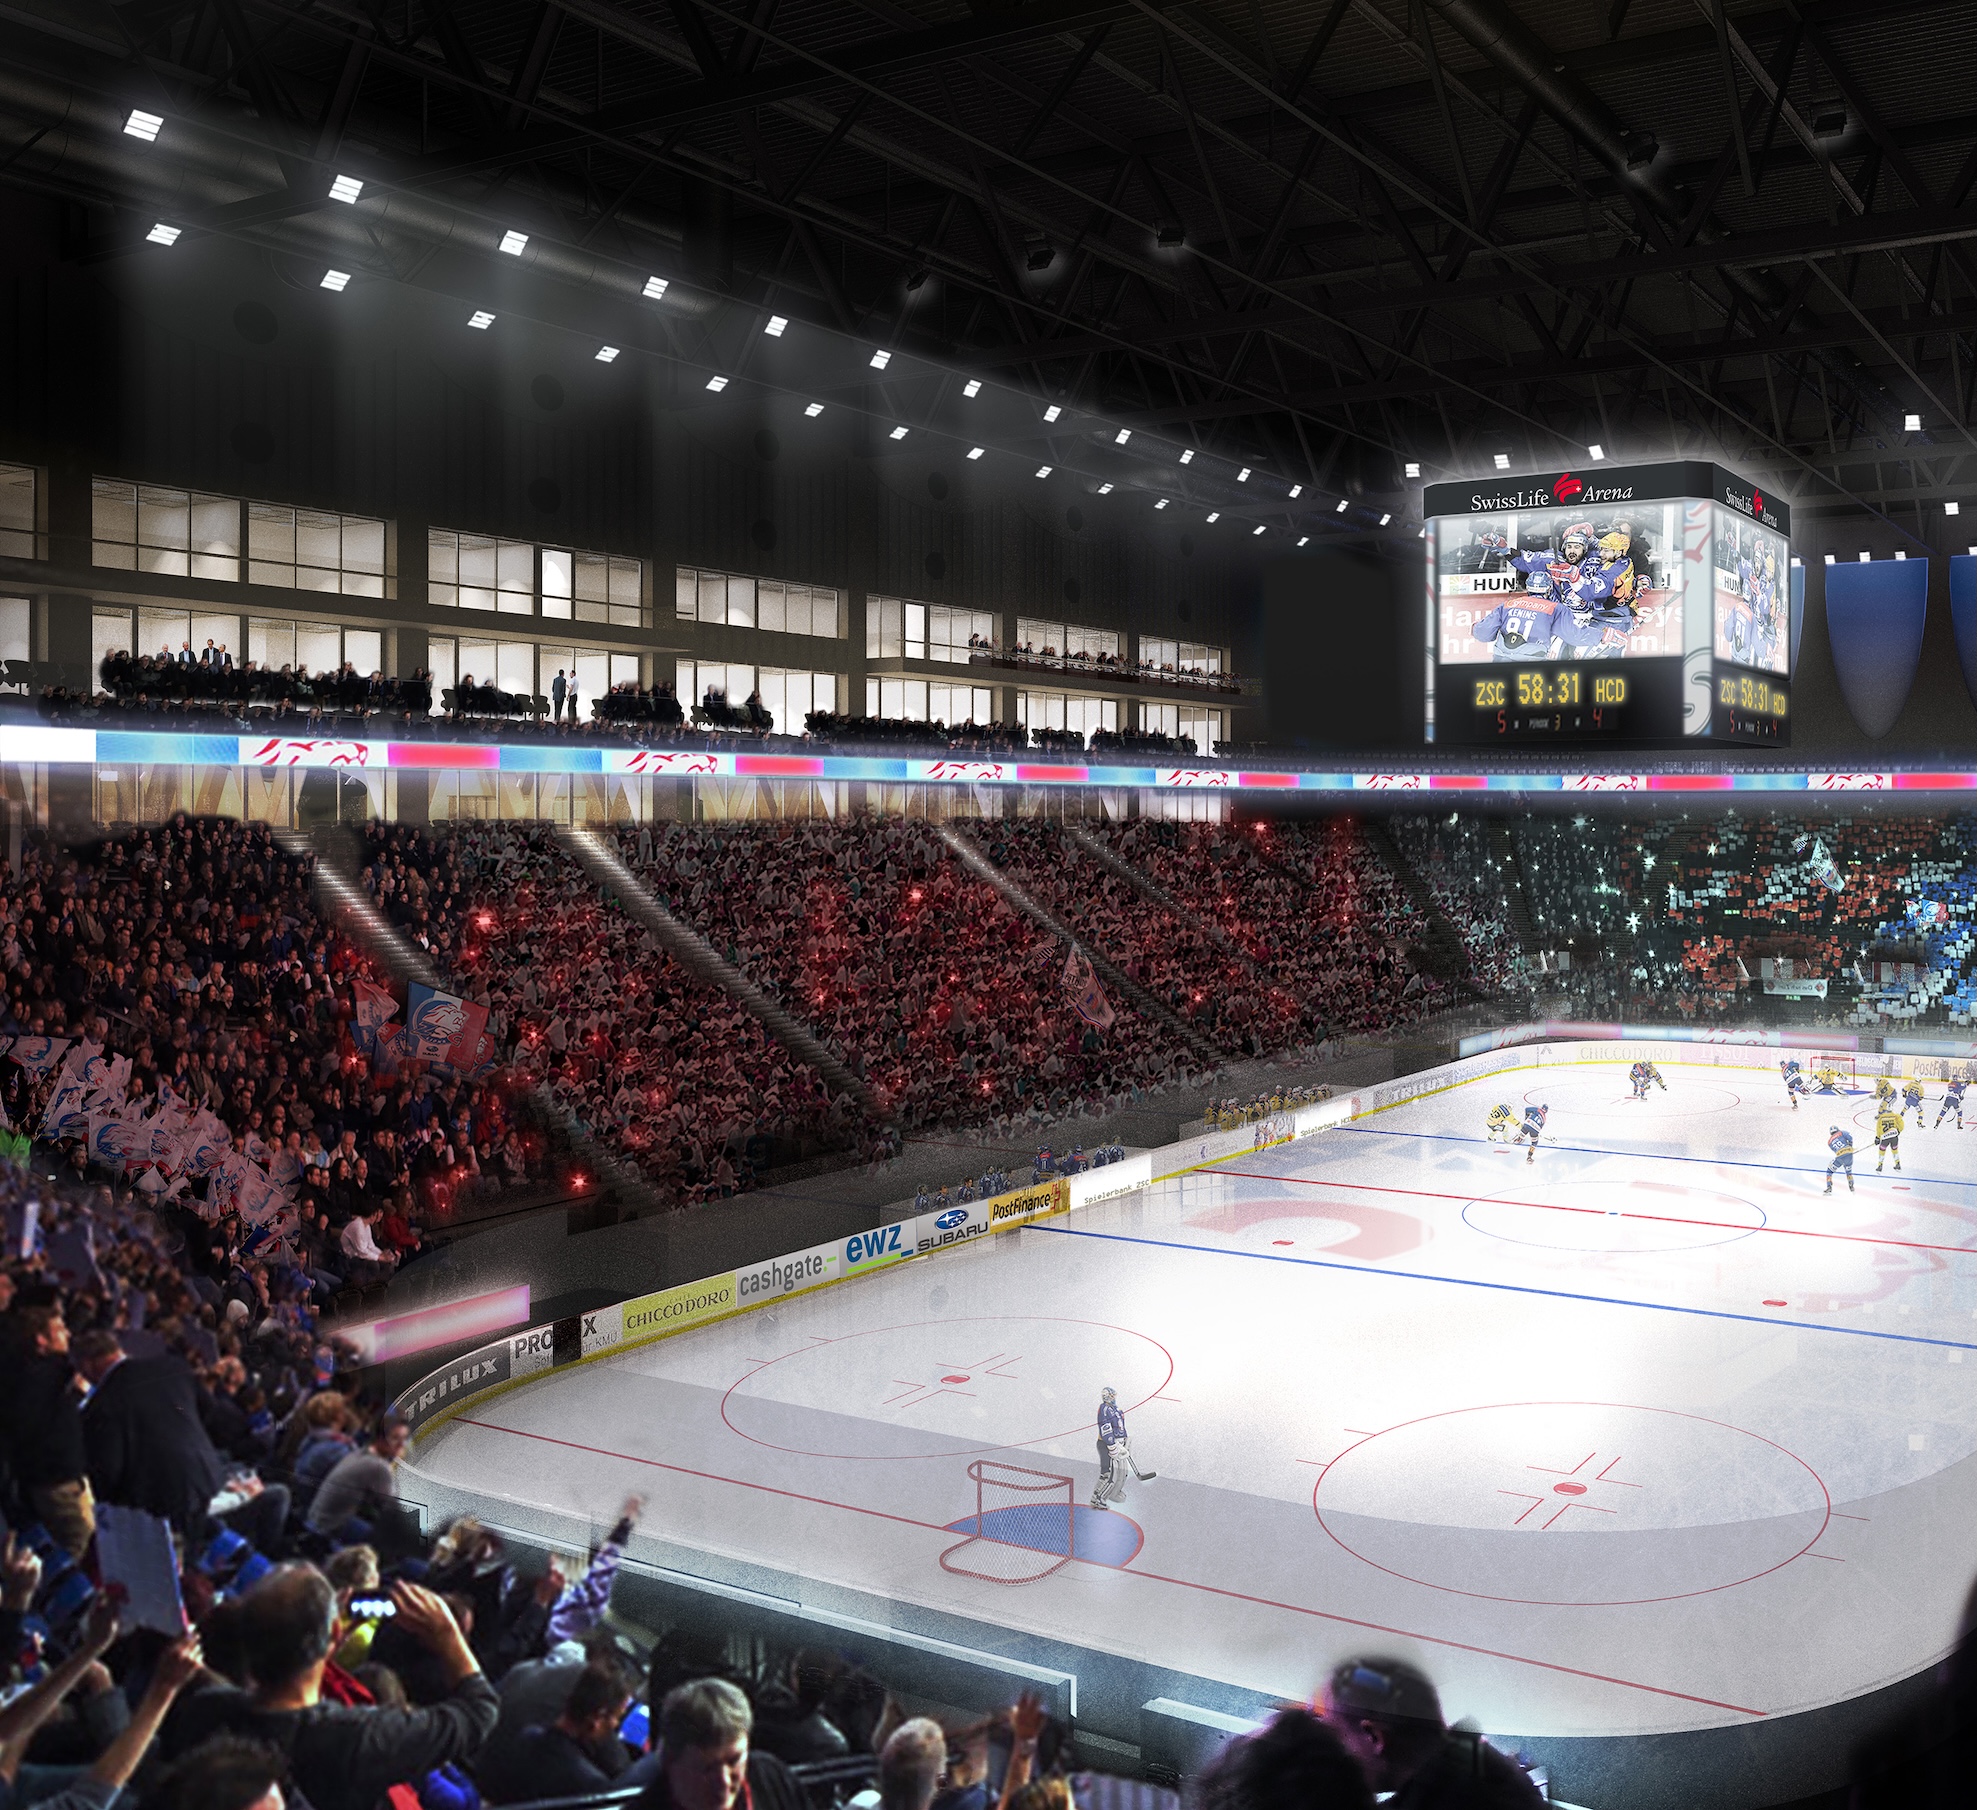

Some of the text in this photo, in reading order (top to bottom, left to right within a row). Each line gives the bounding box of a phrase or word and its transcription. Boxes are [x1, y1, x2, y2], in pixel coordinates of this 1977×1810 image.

[1471, 485, 1634, 511] SwissLife Arena
[1726, 487, 1777, 528] SwissLife Arena
[1476, 673, 1625, 705] ZSC 58:31 HCD
[1721, 679, 1735, 704] ZSC
[1741, 678, 1767, 711] 58:31
[1497, 709, 1506, 733] 5
[992, 1192, 1051, 1221] PostFinance
[1084, 1179, 1150, 1205] Spielerbank ZSC
[917, 1221, 988, 1252] SUBARU
[627, 1302, 683, 1329] CHICCO
[404, 1358, 498, 1422] TRILUX
